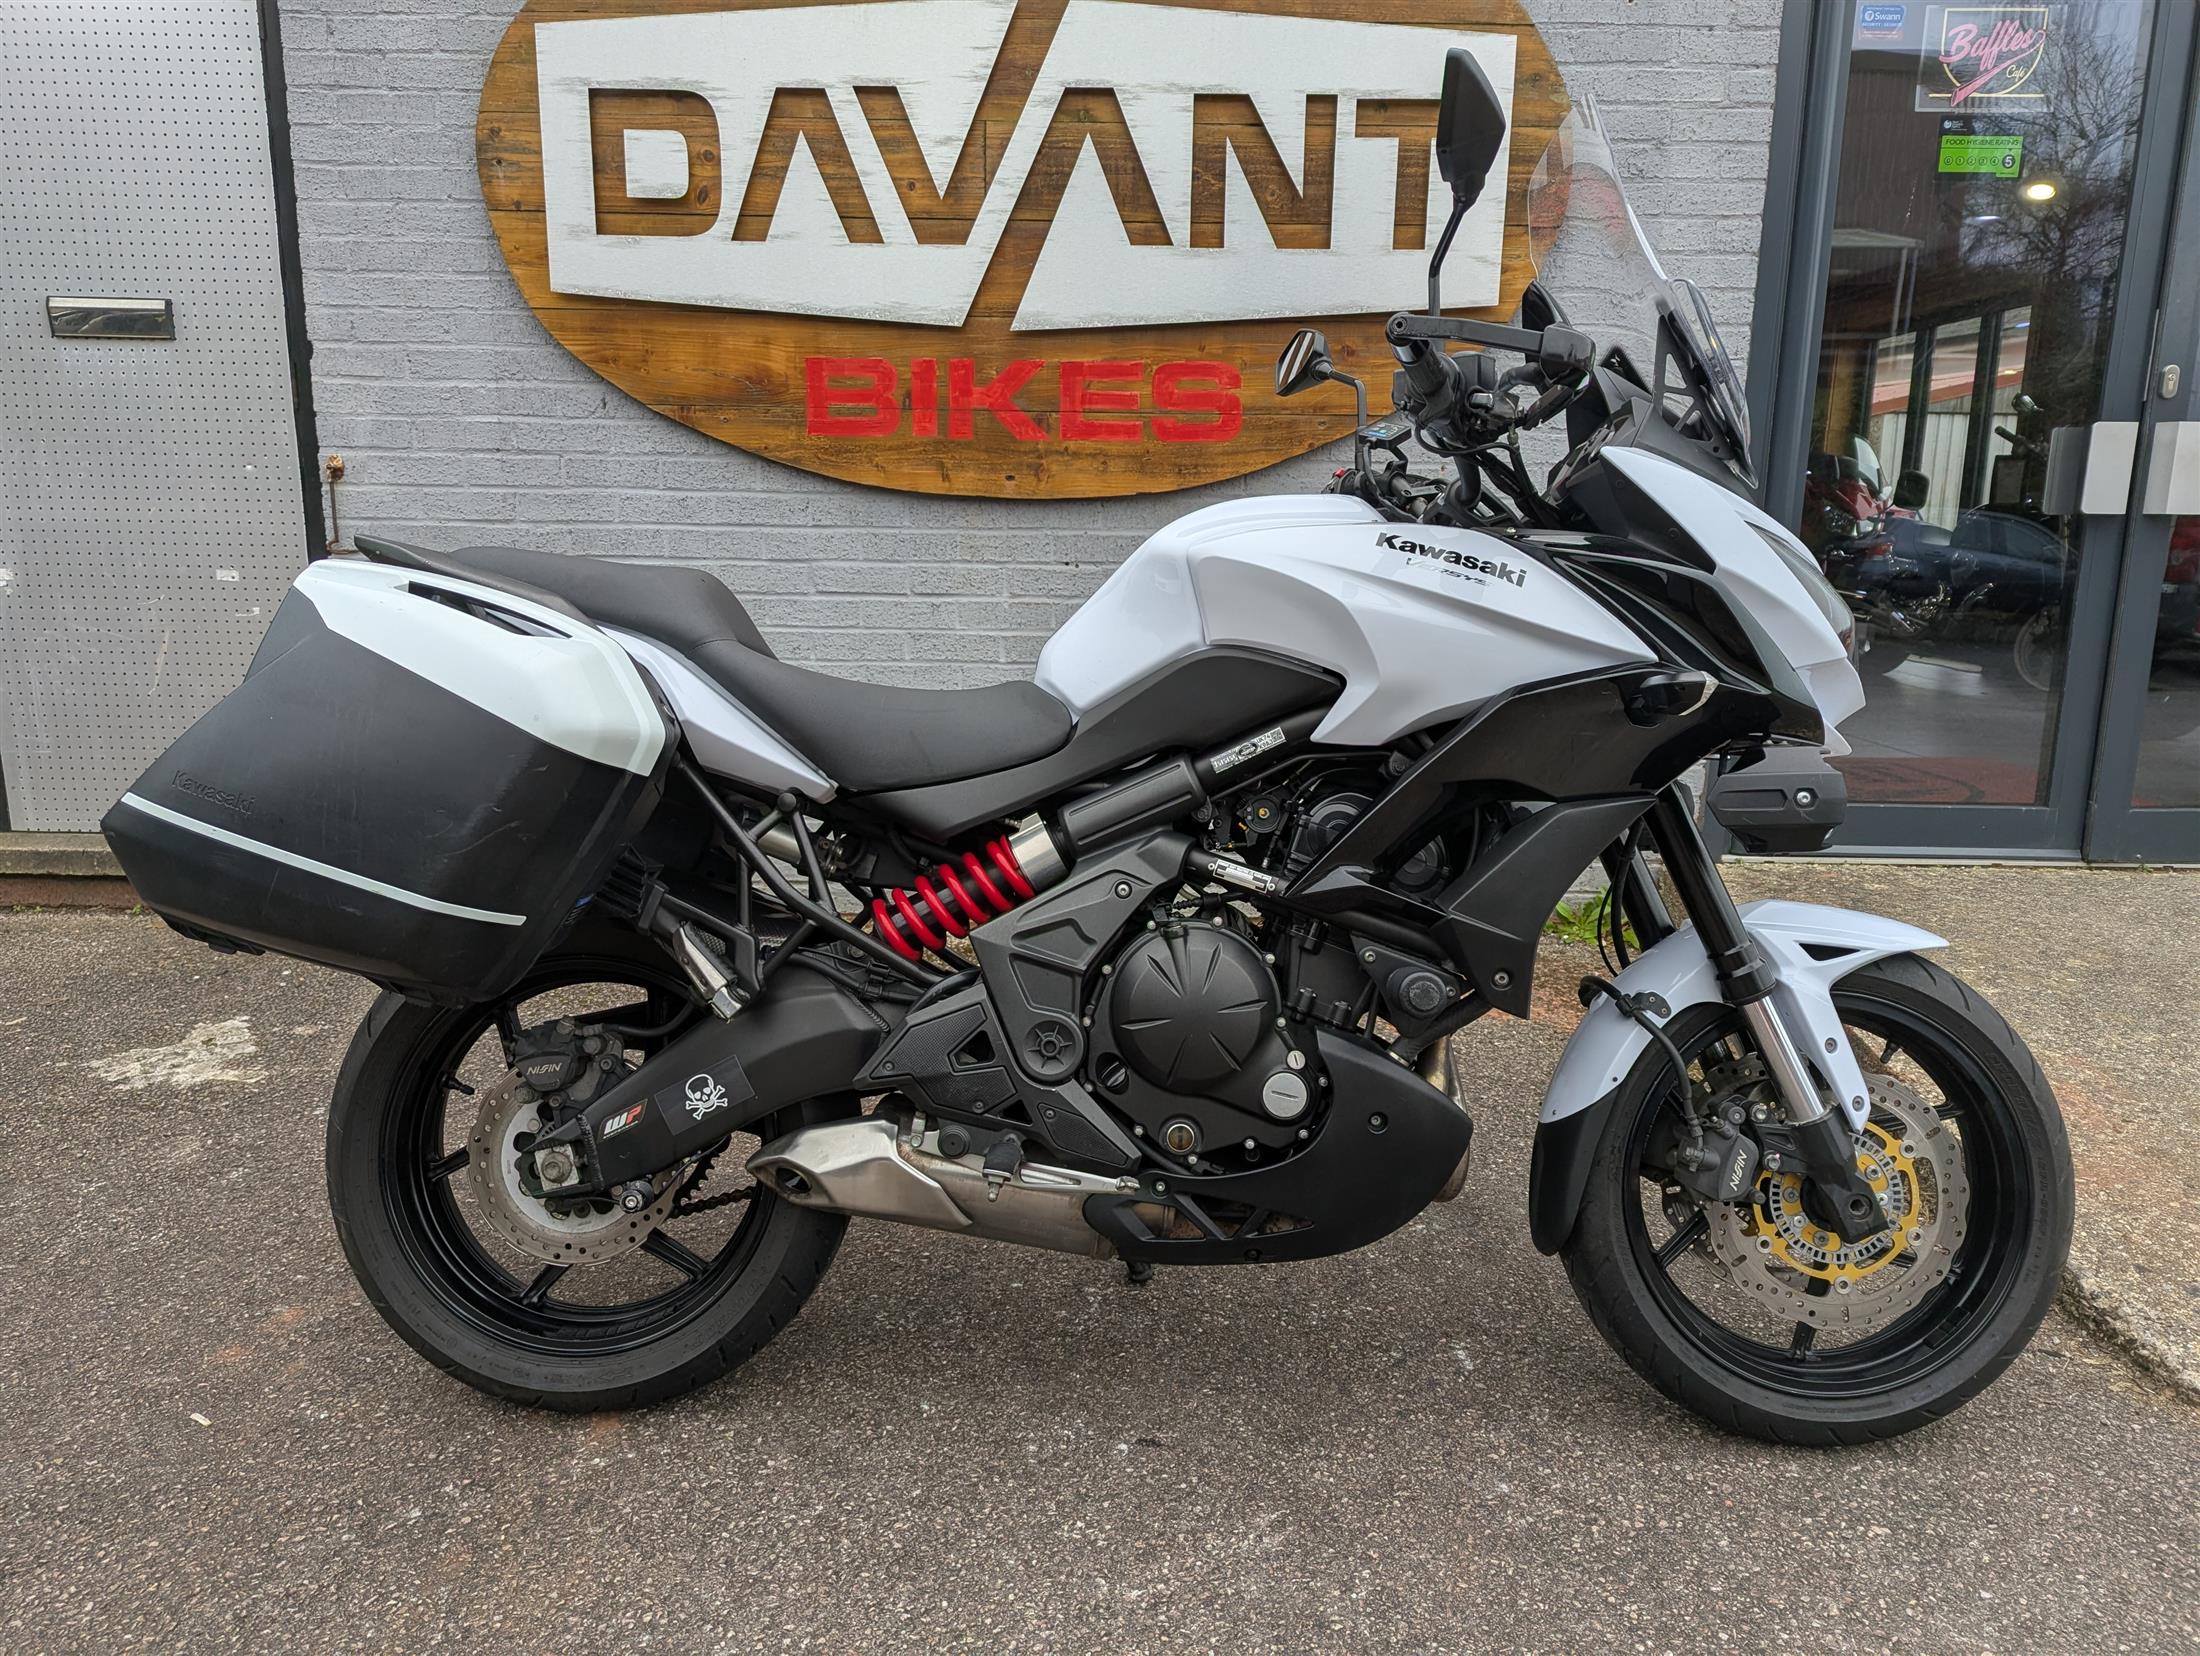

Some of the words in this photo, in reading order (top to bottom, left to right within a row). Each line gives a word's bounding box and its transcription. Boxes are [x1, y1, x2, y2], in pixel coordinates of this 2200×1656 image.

[1874, 11, 1901, 21] Swann
[1939, 19, 2036, 72] Baffles
[1945, 138, 1966, 146] FOOD
[588, 86, 1440, 250] DAVANT
[804, 356, 1243, 443] BIKES
[1375, 531, 1528, 588] Kawasaki
[171, 770, 256, 815] Kawasaki
[526, 1062, 563, 1076] NISSIN
[1728, 1148, 1748, 1192] NISSIN
